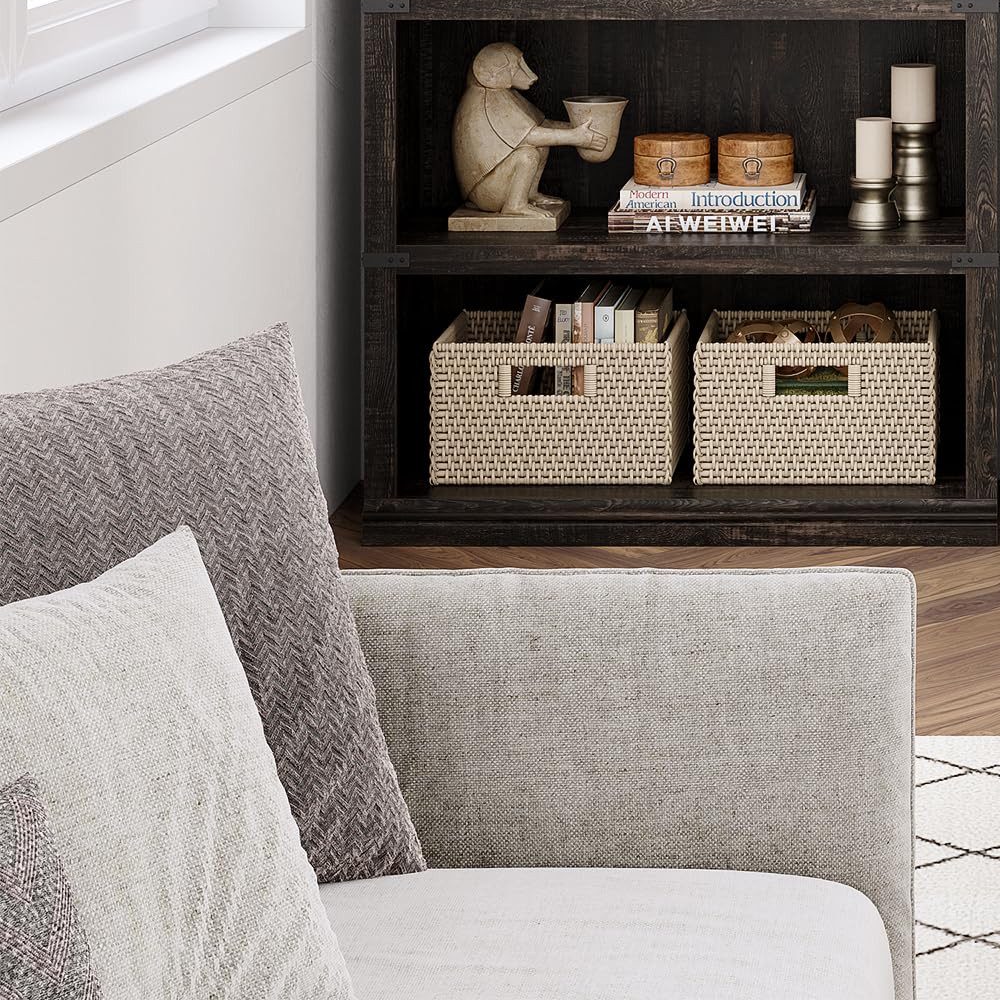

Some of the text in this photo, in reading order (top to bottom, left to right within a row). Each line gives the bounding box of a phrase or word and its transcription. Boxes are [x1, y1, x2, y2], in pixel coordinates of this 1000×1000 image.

[629, 190, 669, 199] Modern
[691, 191, 798, 207] Introduction
[625, 199, 677, 209] American
[646, 215, 777, 232] AI WEIWEI
